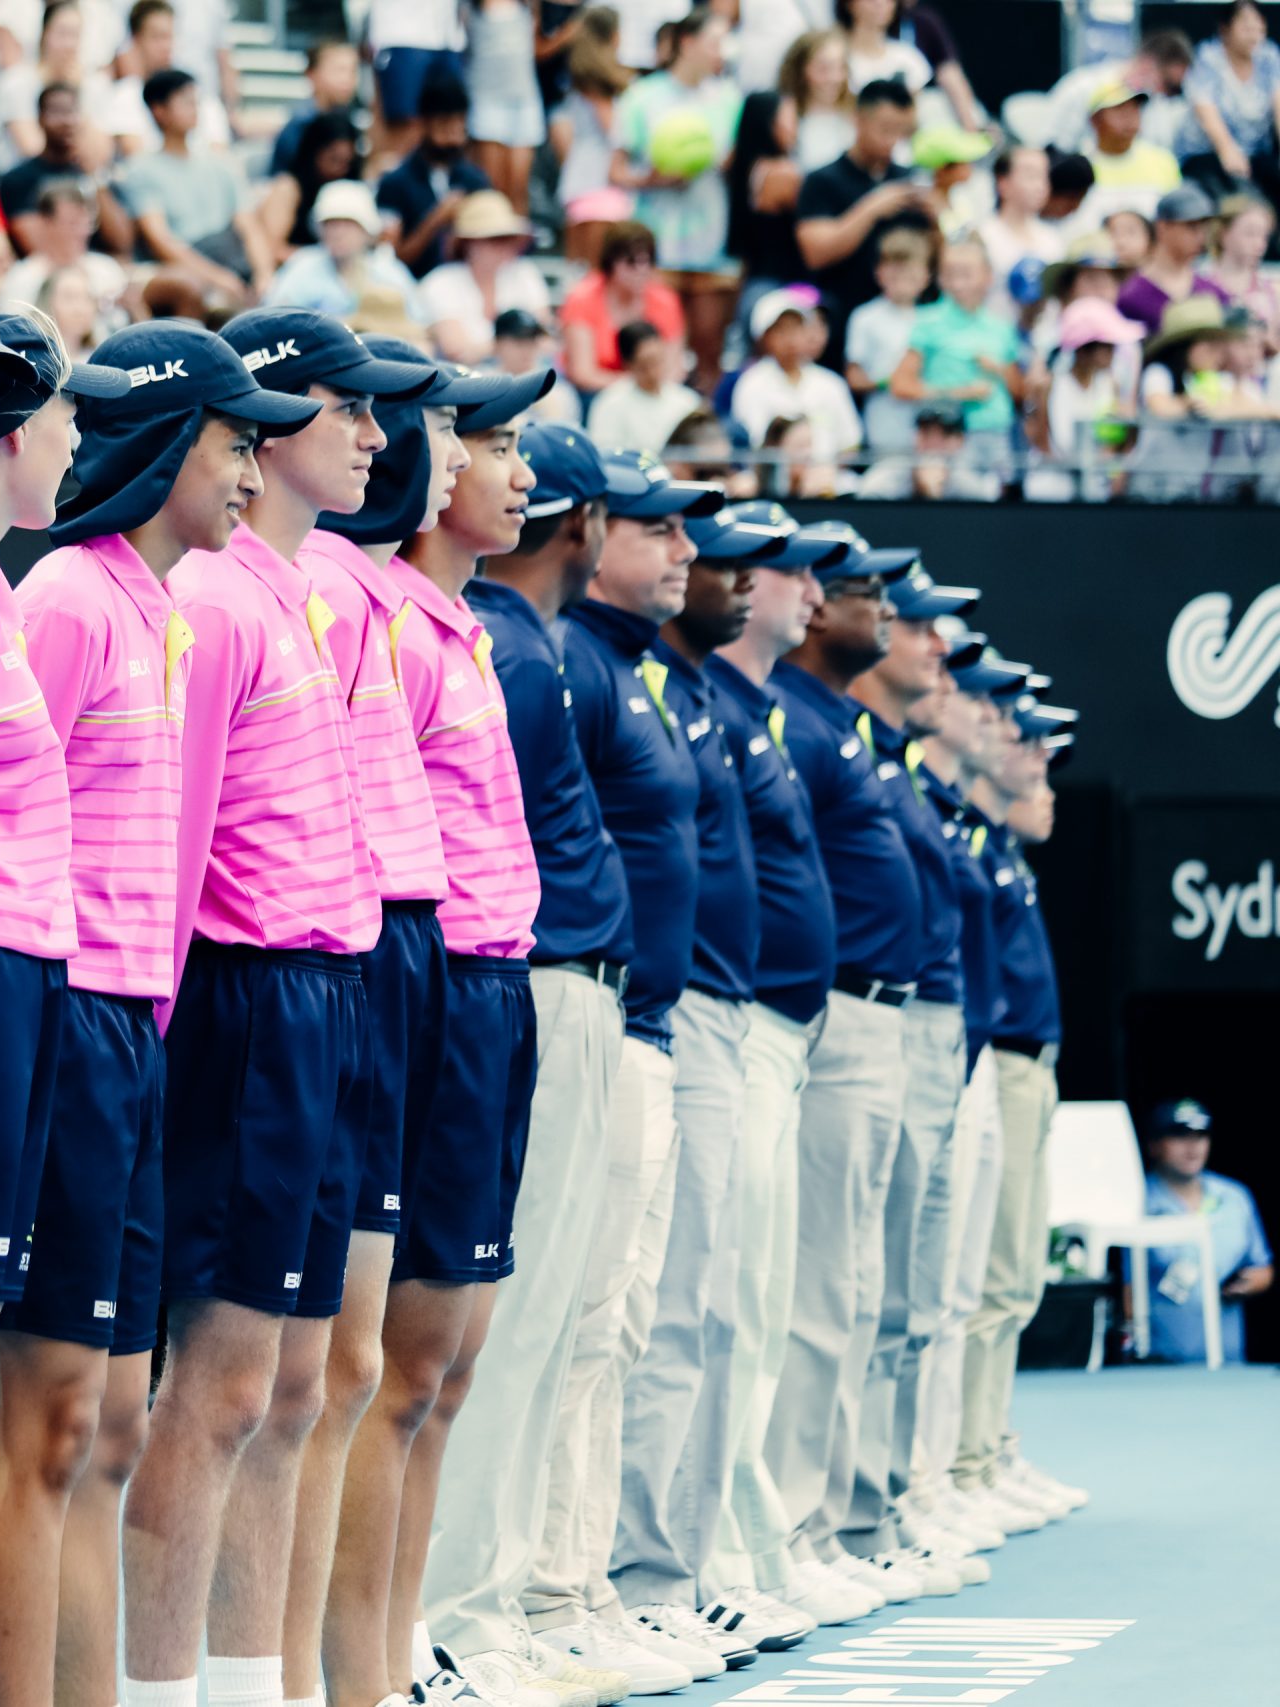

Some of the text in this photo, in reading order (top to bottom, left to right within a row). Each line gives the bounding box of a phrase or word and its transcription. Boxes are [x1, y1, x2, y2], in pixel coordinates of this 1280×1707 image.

[240, 338, 302, 373] BLK
[129, 358, 189, 388] BLK
[127, 656, 151, 679] BLK
[383, 1193, 401, 1211] BL
[474, 1242, 499, 1260] BLK
